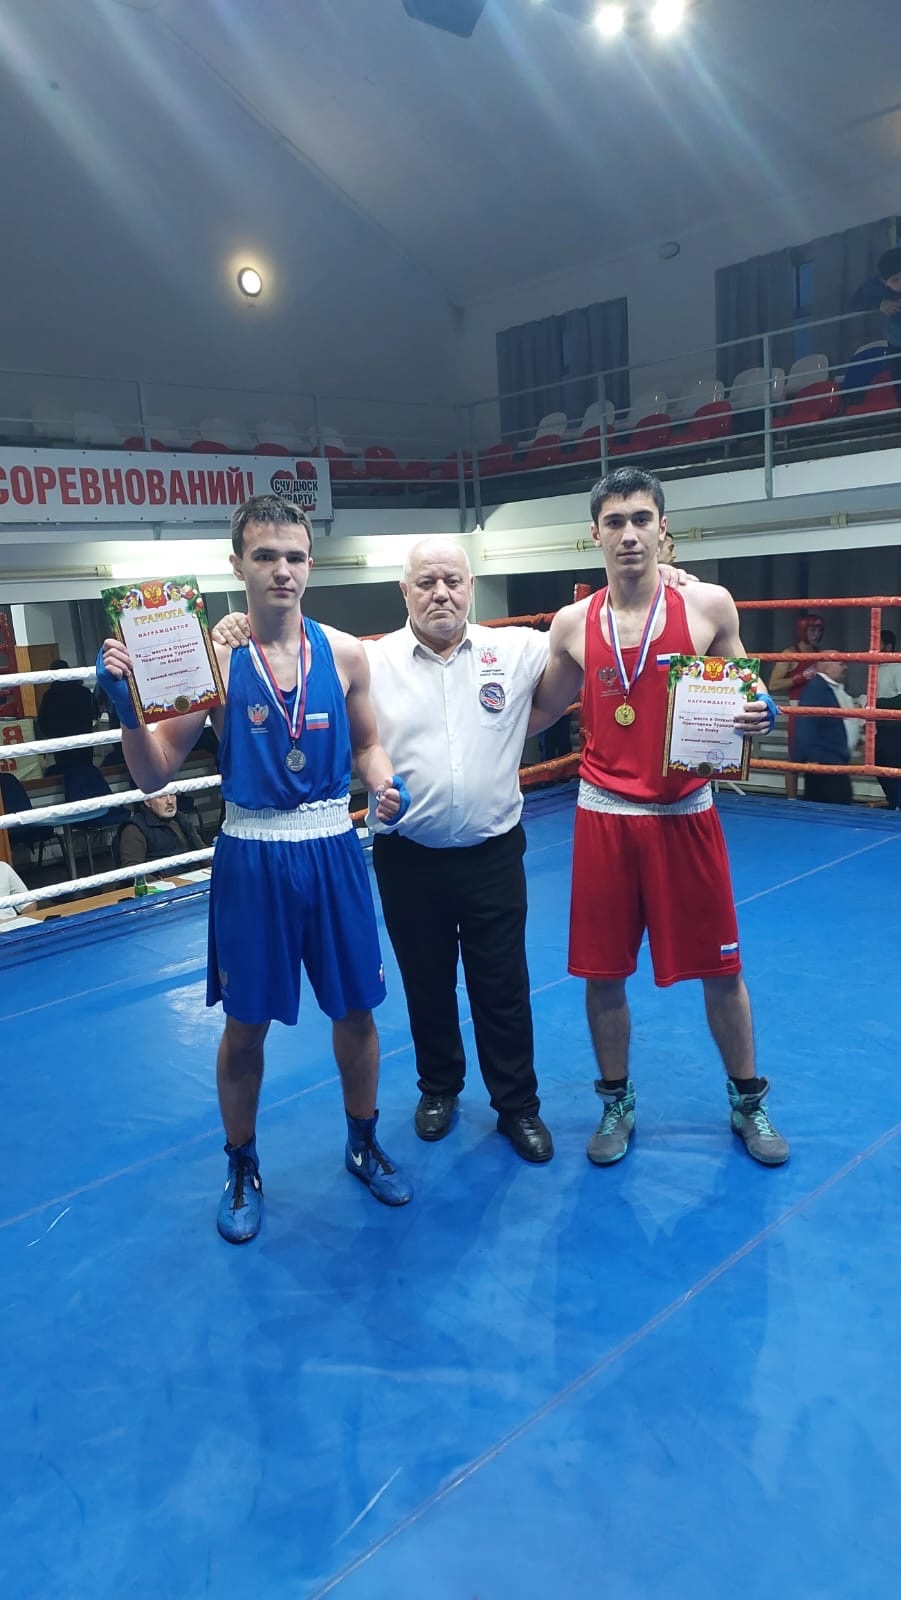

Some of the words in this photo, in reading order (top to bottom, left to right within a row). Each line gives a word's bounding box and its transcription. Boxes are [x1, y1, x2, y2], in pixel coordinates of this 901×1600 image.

[274, 479, 290, 491] СЧУ
[134, 608, 185, 625] ГРАМОТА
[138, 624, 188, 637] НАГРАЖДАЕТСЯ
[688, 685, 736, 694] ГРАМОТА
